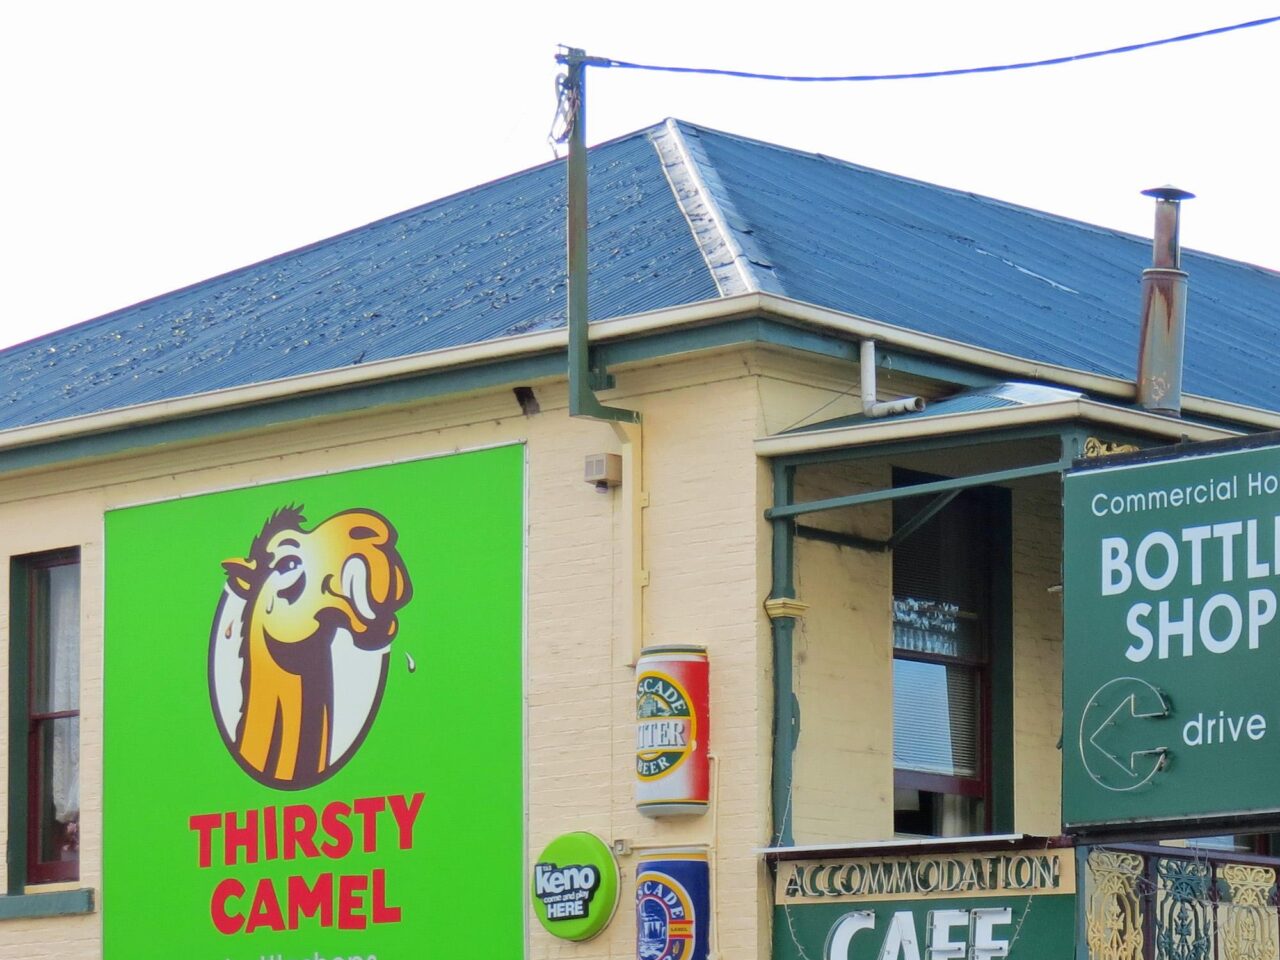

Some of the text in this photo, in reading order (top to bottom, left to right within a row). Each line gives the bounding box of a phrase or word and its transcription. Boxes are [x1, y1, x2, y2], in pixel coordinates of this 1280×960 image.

[1091, 475, 1237, 517] Commercial
[1124, 588, 1277, 663] SHOP
[1182, 710, 1267, 747] drive
[189, 792, 425, 869] THIRSTY
[535, 865, 595, 895] keno
[785, 855, 1060, 896] ACCOMMODATION
[210, 868, 401, 935] CAMEL
[543, 889, 590, 904] come and play
[547, 900, 584, 919] HERE
